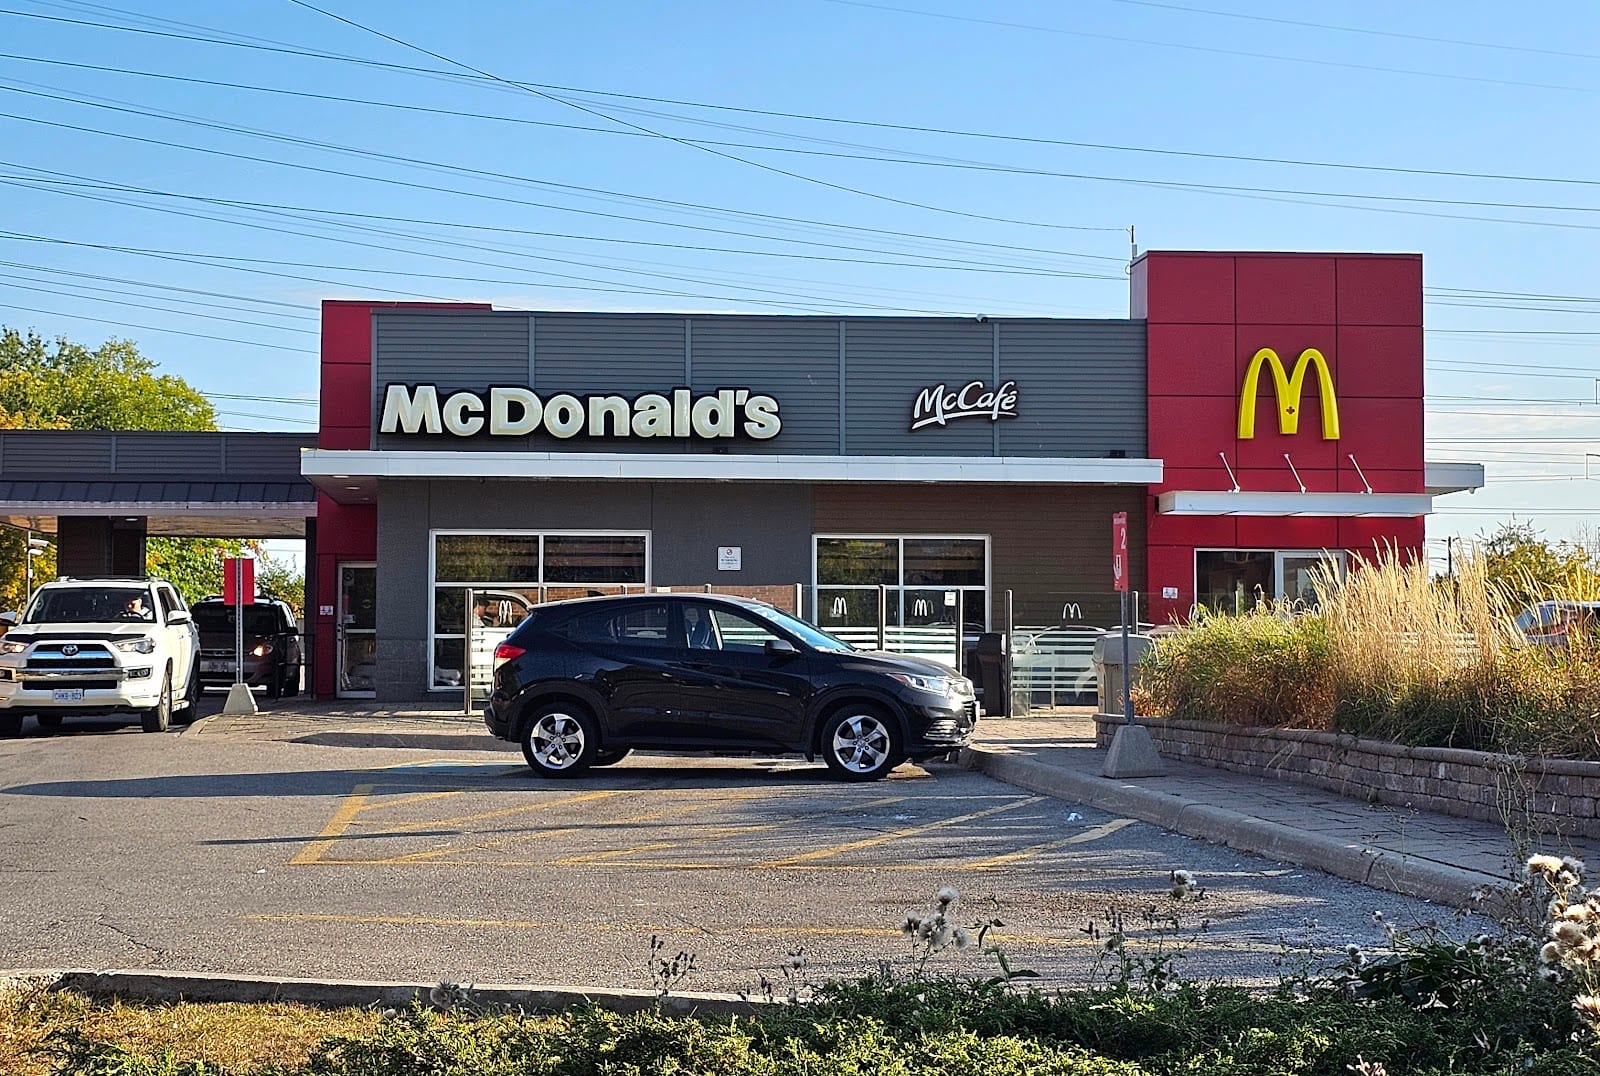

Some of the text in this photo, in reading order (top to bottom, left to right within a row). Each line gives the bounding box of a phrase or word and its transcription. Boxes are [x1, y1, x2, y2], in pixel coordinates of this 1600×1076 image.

[380, 385, 782, 439] McDonald's
[912, 381, 1017, 427] McCafé
[1120, 527, 1127, 550] 2
